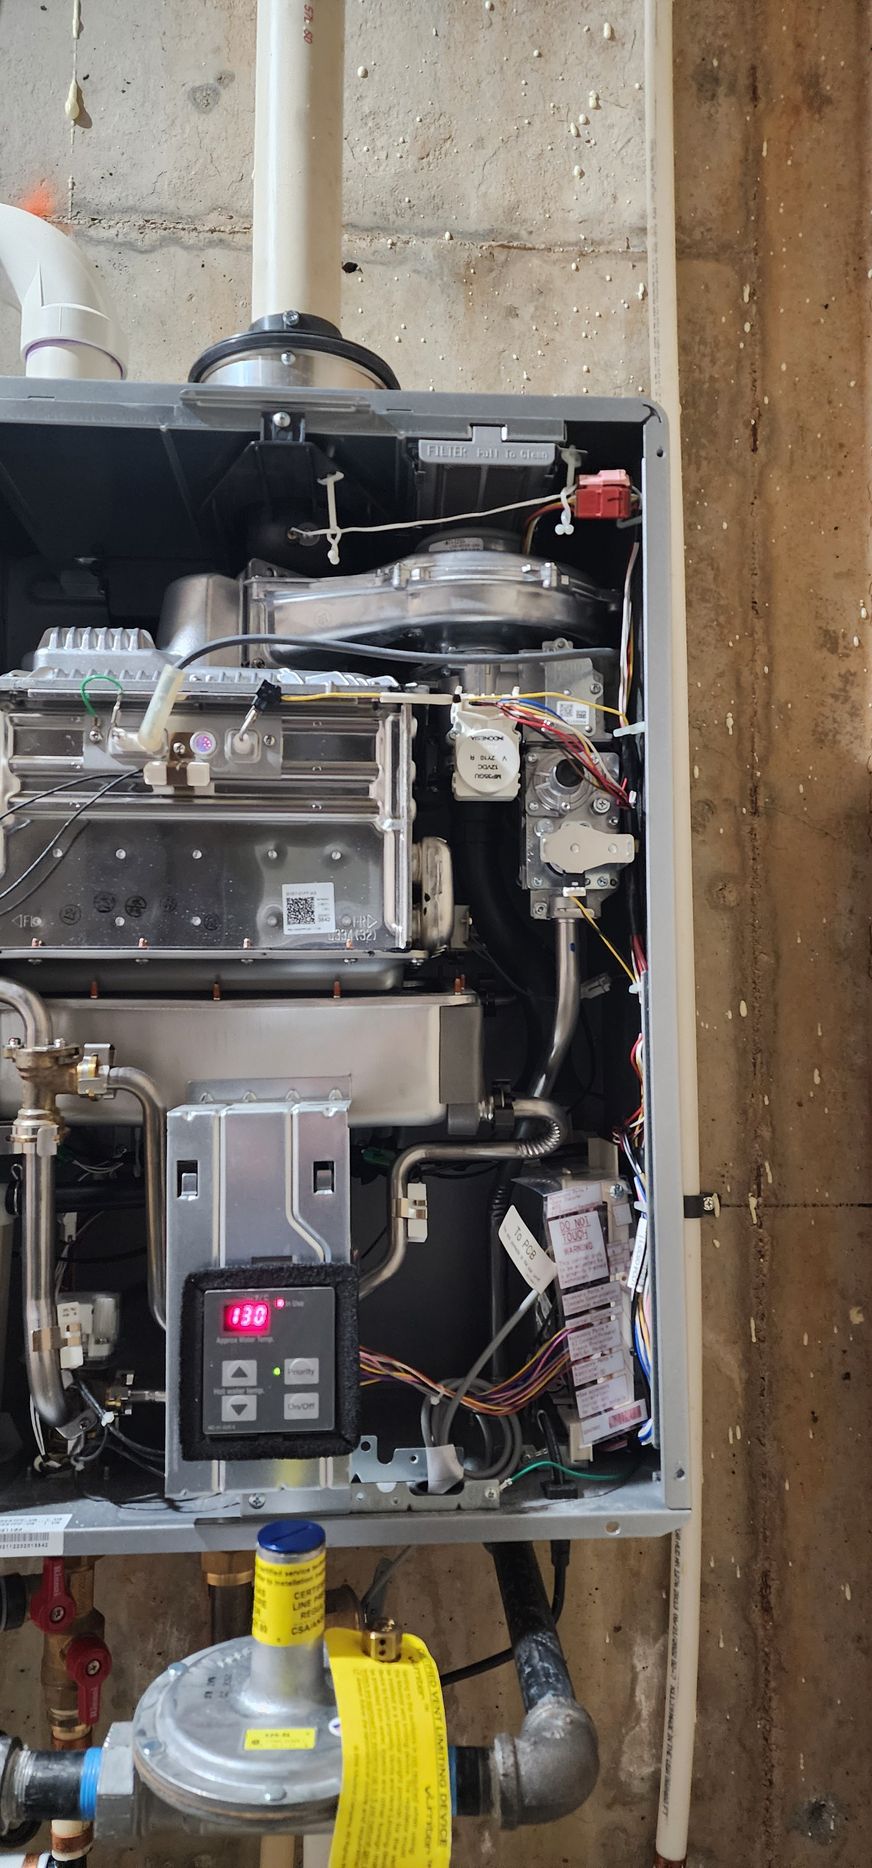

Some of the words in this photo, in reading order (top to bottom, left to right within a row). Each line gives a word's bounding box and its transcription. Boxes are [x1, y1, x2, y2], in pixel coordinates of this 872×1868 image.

[427, 445, 467, 458] FILTER
[559, 1221, 574, 1234] DO
[512, 1225, 524, 1243] To
[522, 1239, 537, 1261] PCB
[562, 1230, 589, 1243] TOUCH
[563, 1243, 594, 1256] WARNING
[232, 1304, 267, 1327] 130
[288, 1368, 315, 1376] Priority
[288, 1402, 315, 1411] On/Off
[293, 1599, 311, 1611] LINE
[430, 1691, 443, 1722] VENT
[435, 1726, 447, 1788] LIMITING
[439, 1793, 448, 1848] DEVICE
